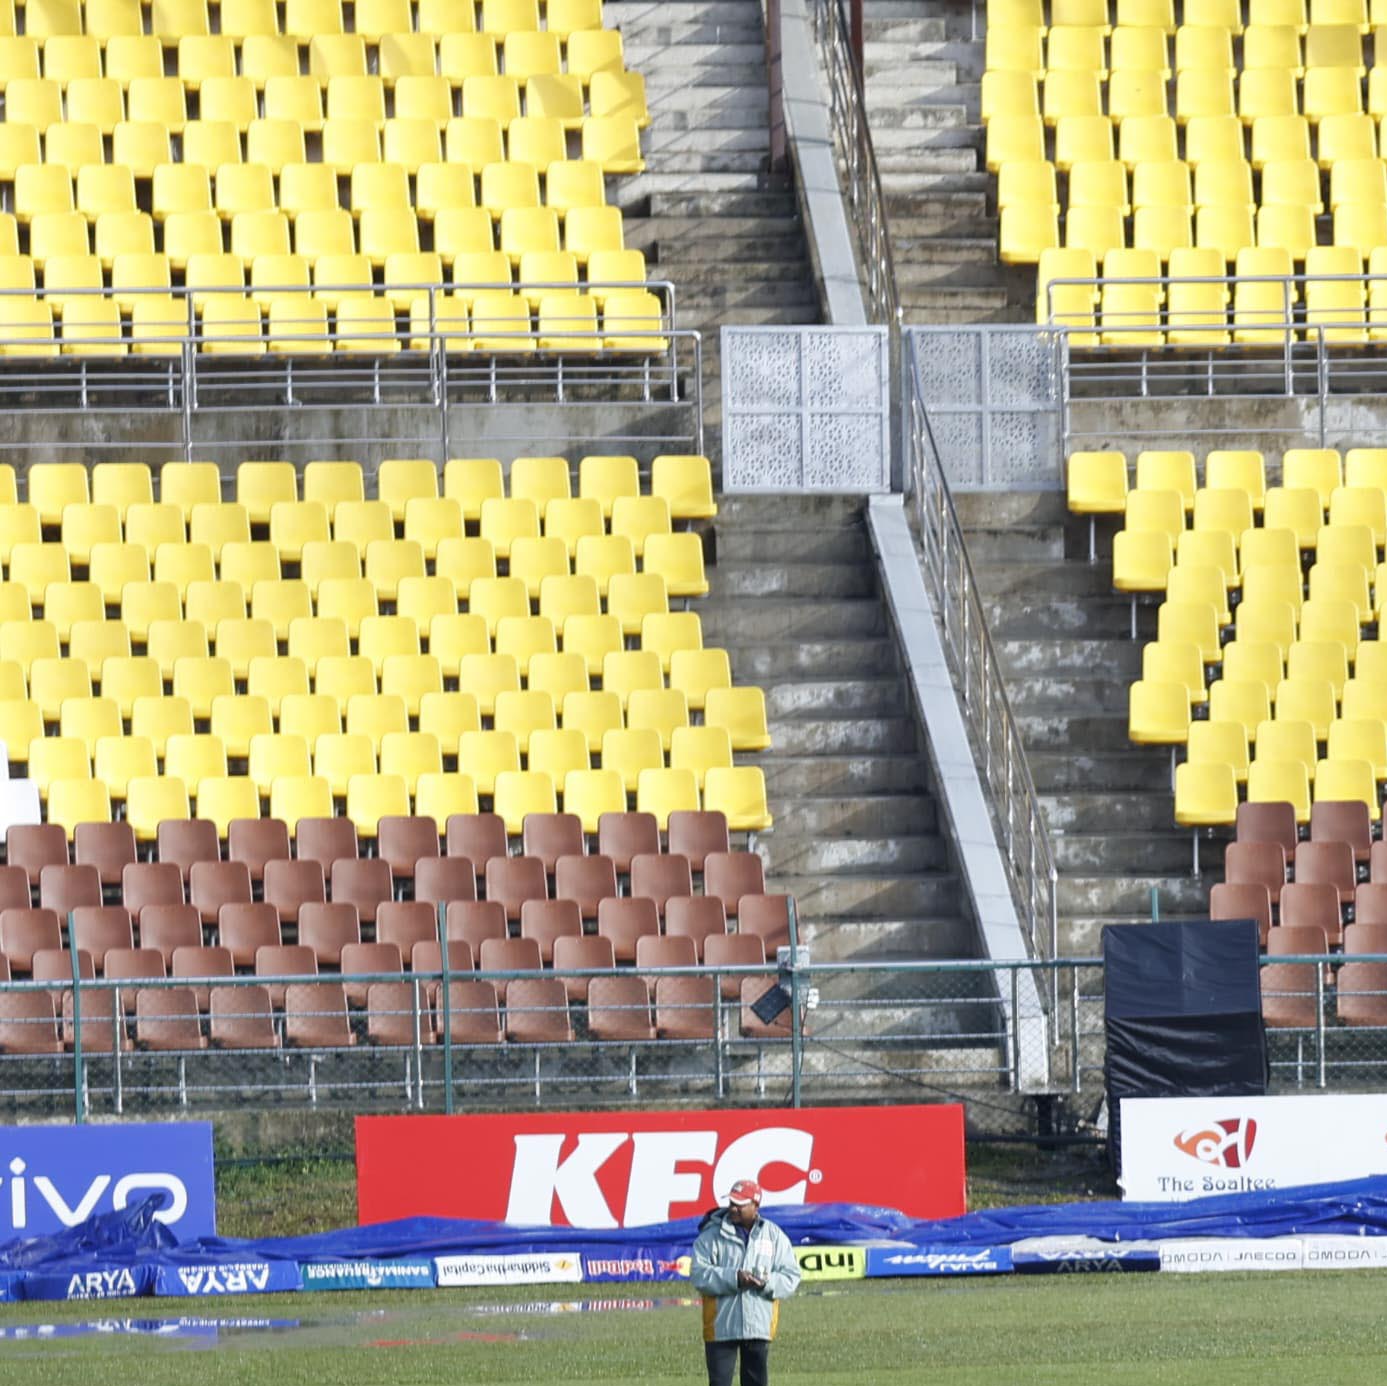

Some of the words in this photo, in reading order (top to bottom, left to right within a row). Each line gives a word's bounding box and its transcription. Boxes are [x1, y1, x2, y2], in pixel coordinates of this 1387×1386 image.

[0, 1157, 188, 1228] ivo
[1157, 1176, 1194, 1192] The
[1202, 1175, 1276, 1192] Soaltee
[67, 1268, 136, 1295] ARYA
[177, 1265, 269, 1294] ARYA
